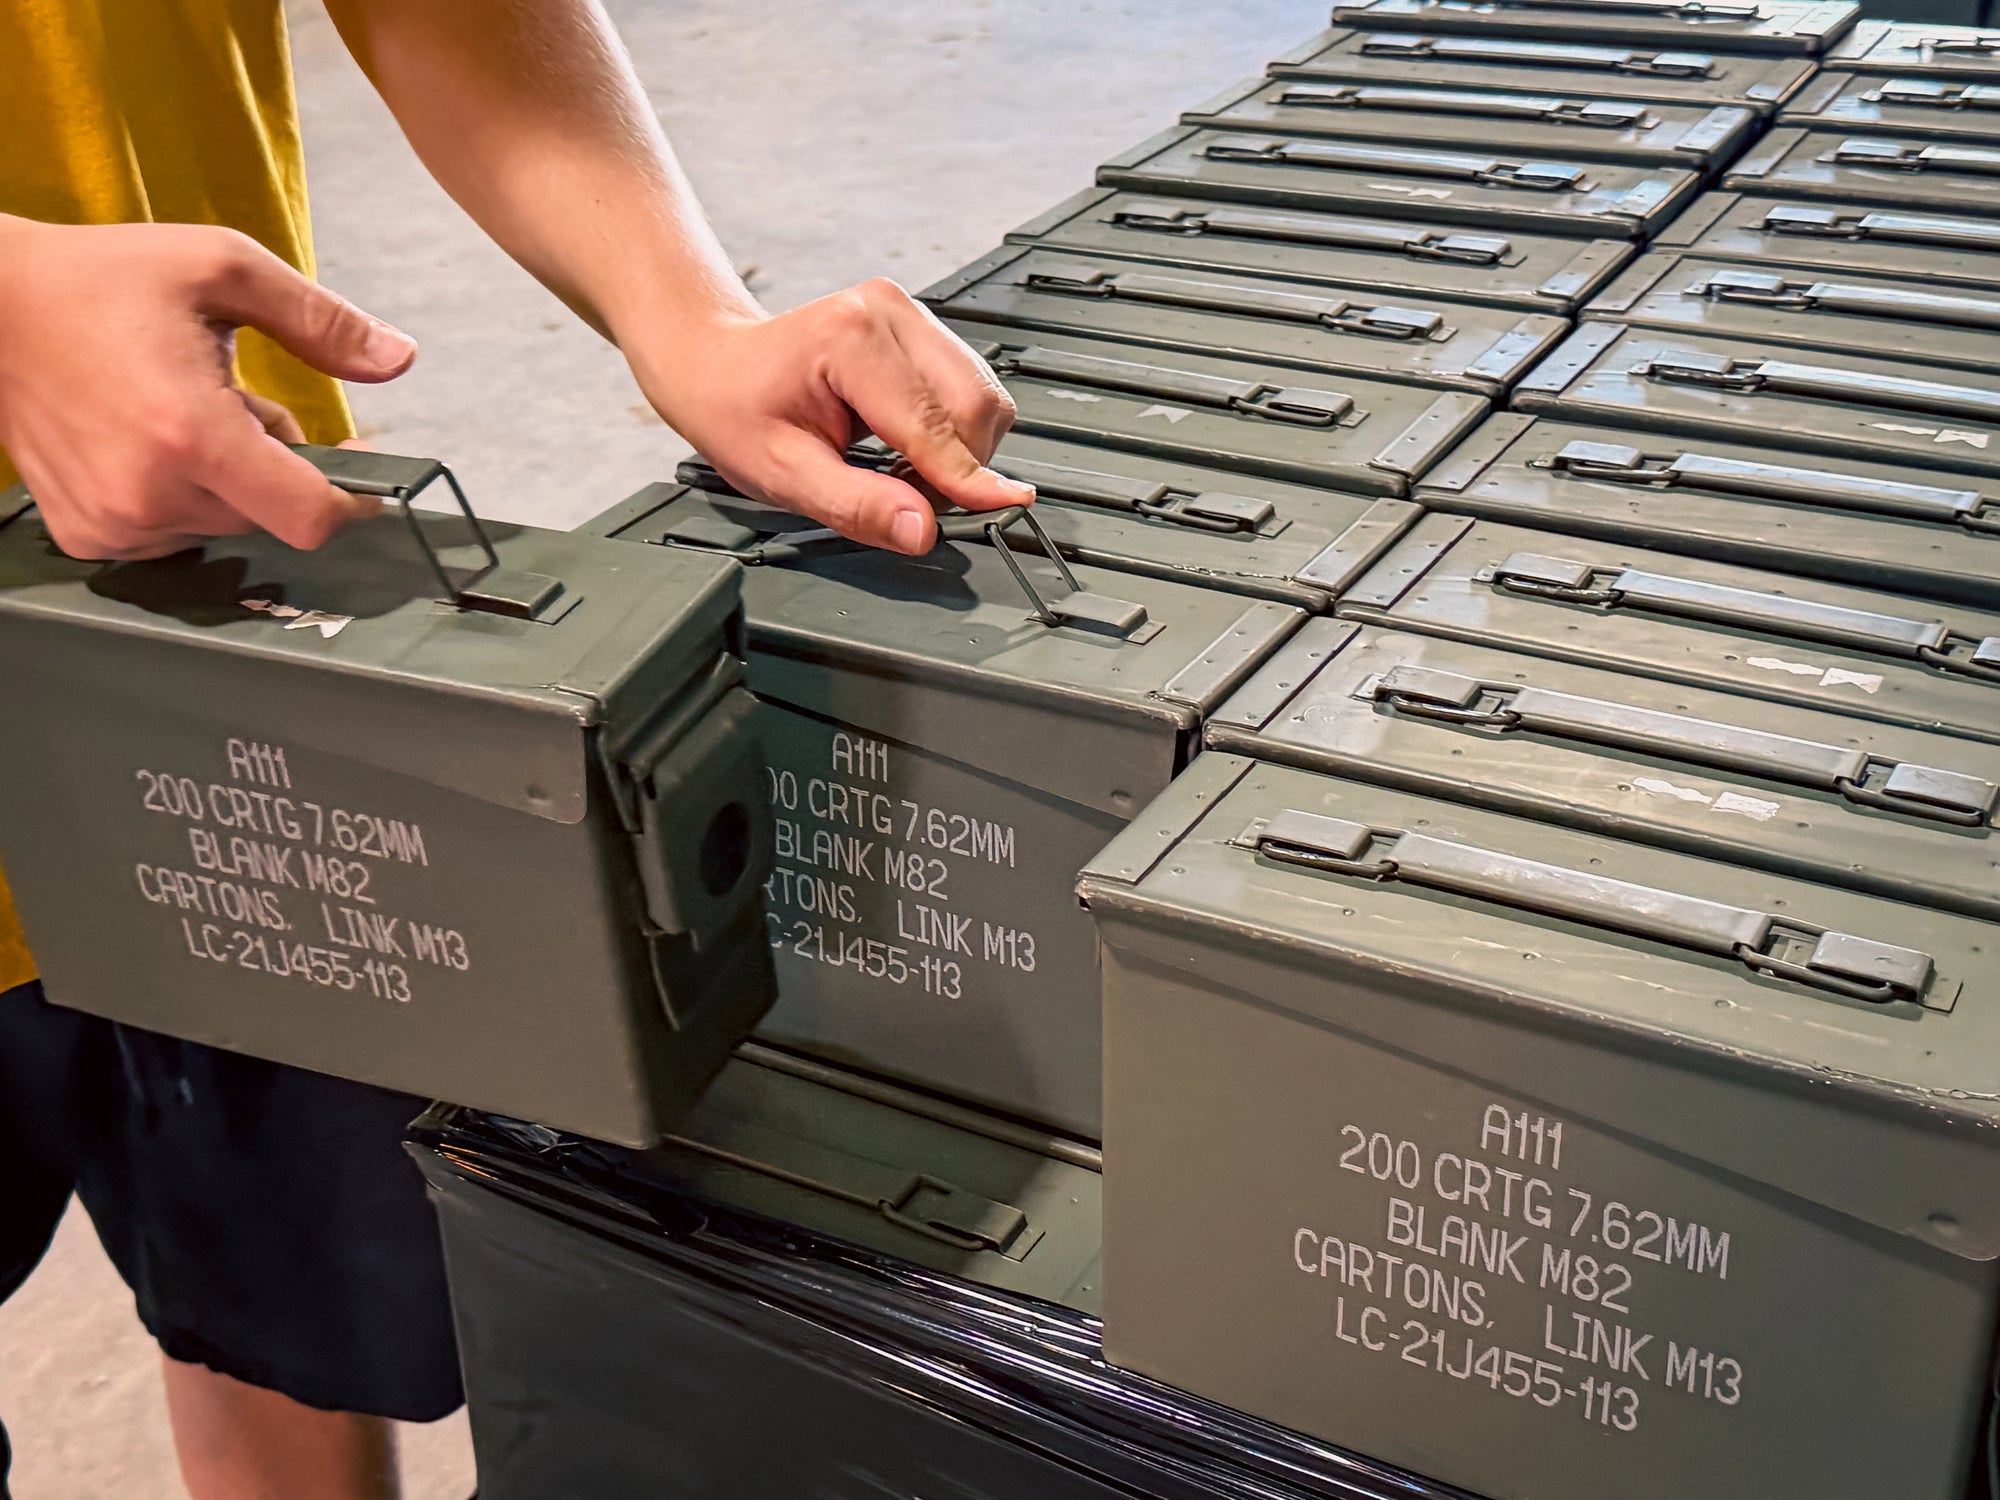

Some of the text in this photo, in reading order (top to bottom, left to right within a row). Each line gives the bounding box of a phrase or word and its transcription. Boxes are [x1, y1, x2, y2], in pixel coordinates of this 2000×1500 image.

[227, 738, 291, 789] A111
[832, 732, 889, 783] A111
[136, 769, 428, 866] 200 CRTG 7.62MM
[775, 818, 948, 900] BLANK M82
[808, 778, 892, 835] CRTG
[901, 799, 1015, 868] 7.62MM
[189, 828, 375, 904] BLANK M82
[182, 918, 411, 1002] LC-21J455-113
[322, 902, 407, 958] LINK
[409, 921, 470, 971] M13
[766, 912, 962, 1000] C-21J455-113
[897, 899, 973, 957] LINK
[983, 921, 1036, 972] M13
[1480, 1104, 1564, 1170] A111
[1339, 1124, 1730, 1280] 200 CRTG 7.62MM
[1386, 1196, 1632, 1314] BLANK M82
[1293, 1227, 1743, 1406] CARTONS, LINK M13
[1336, 1296, 1640, 1431] LC-21J455-113
